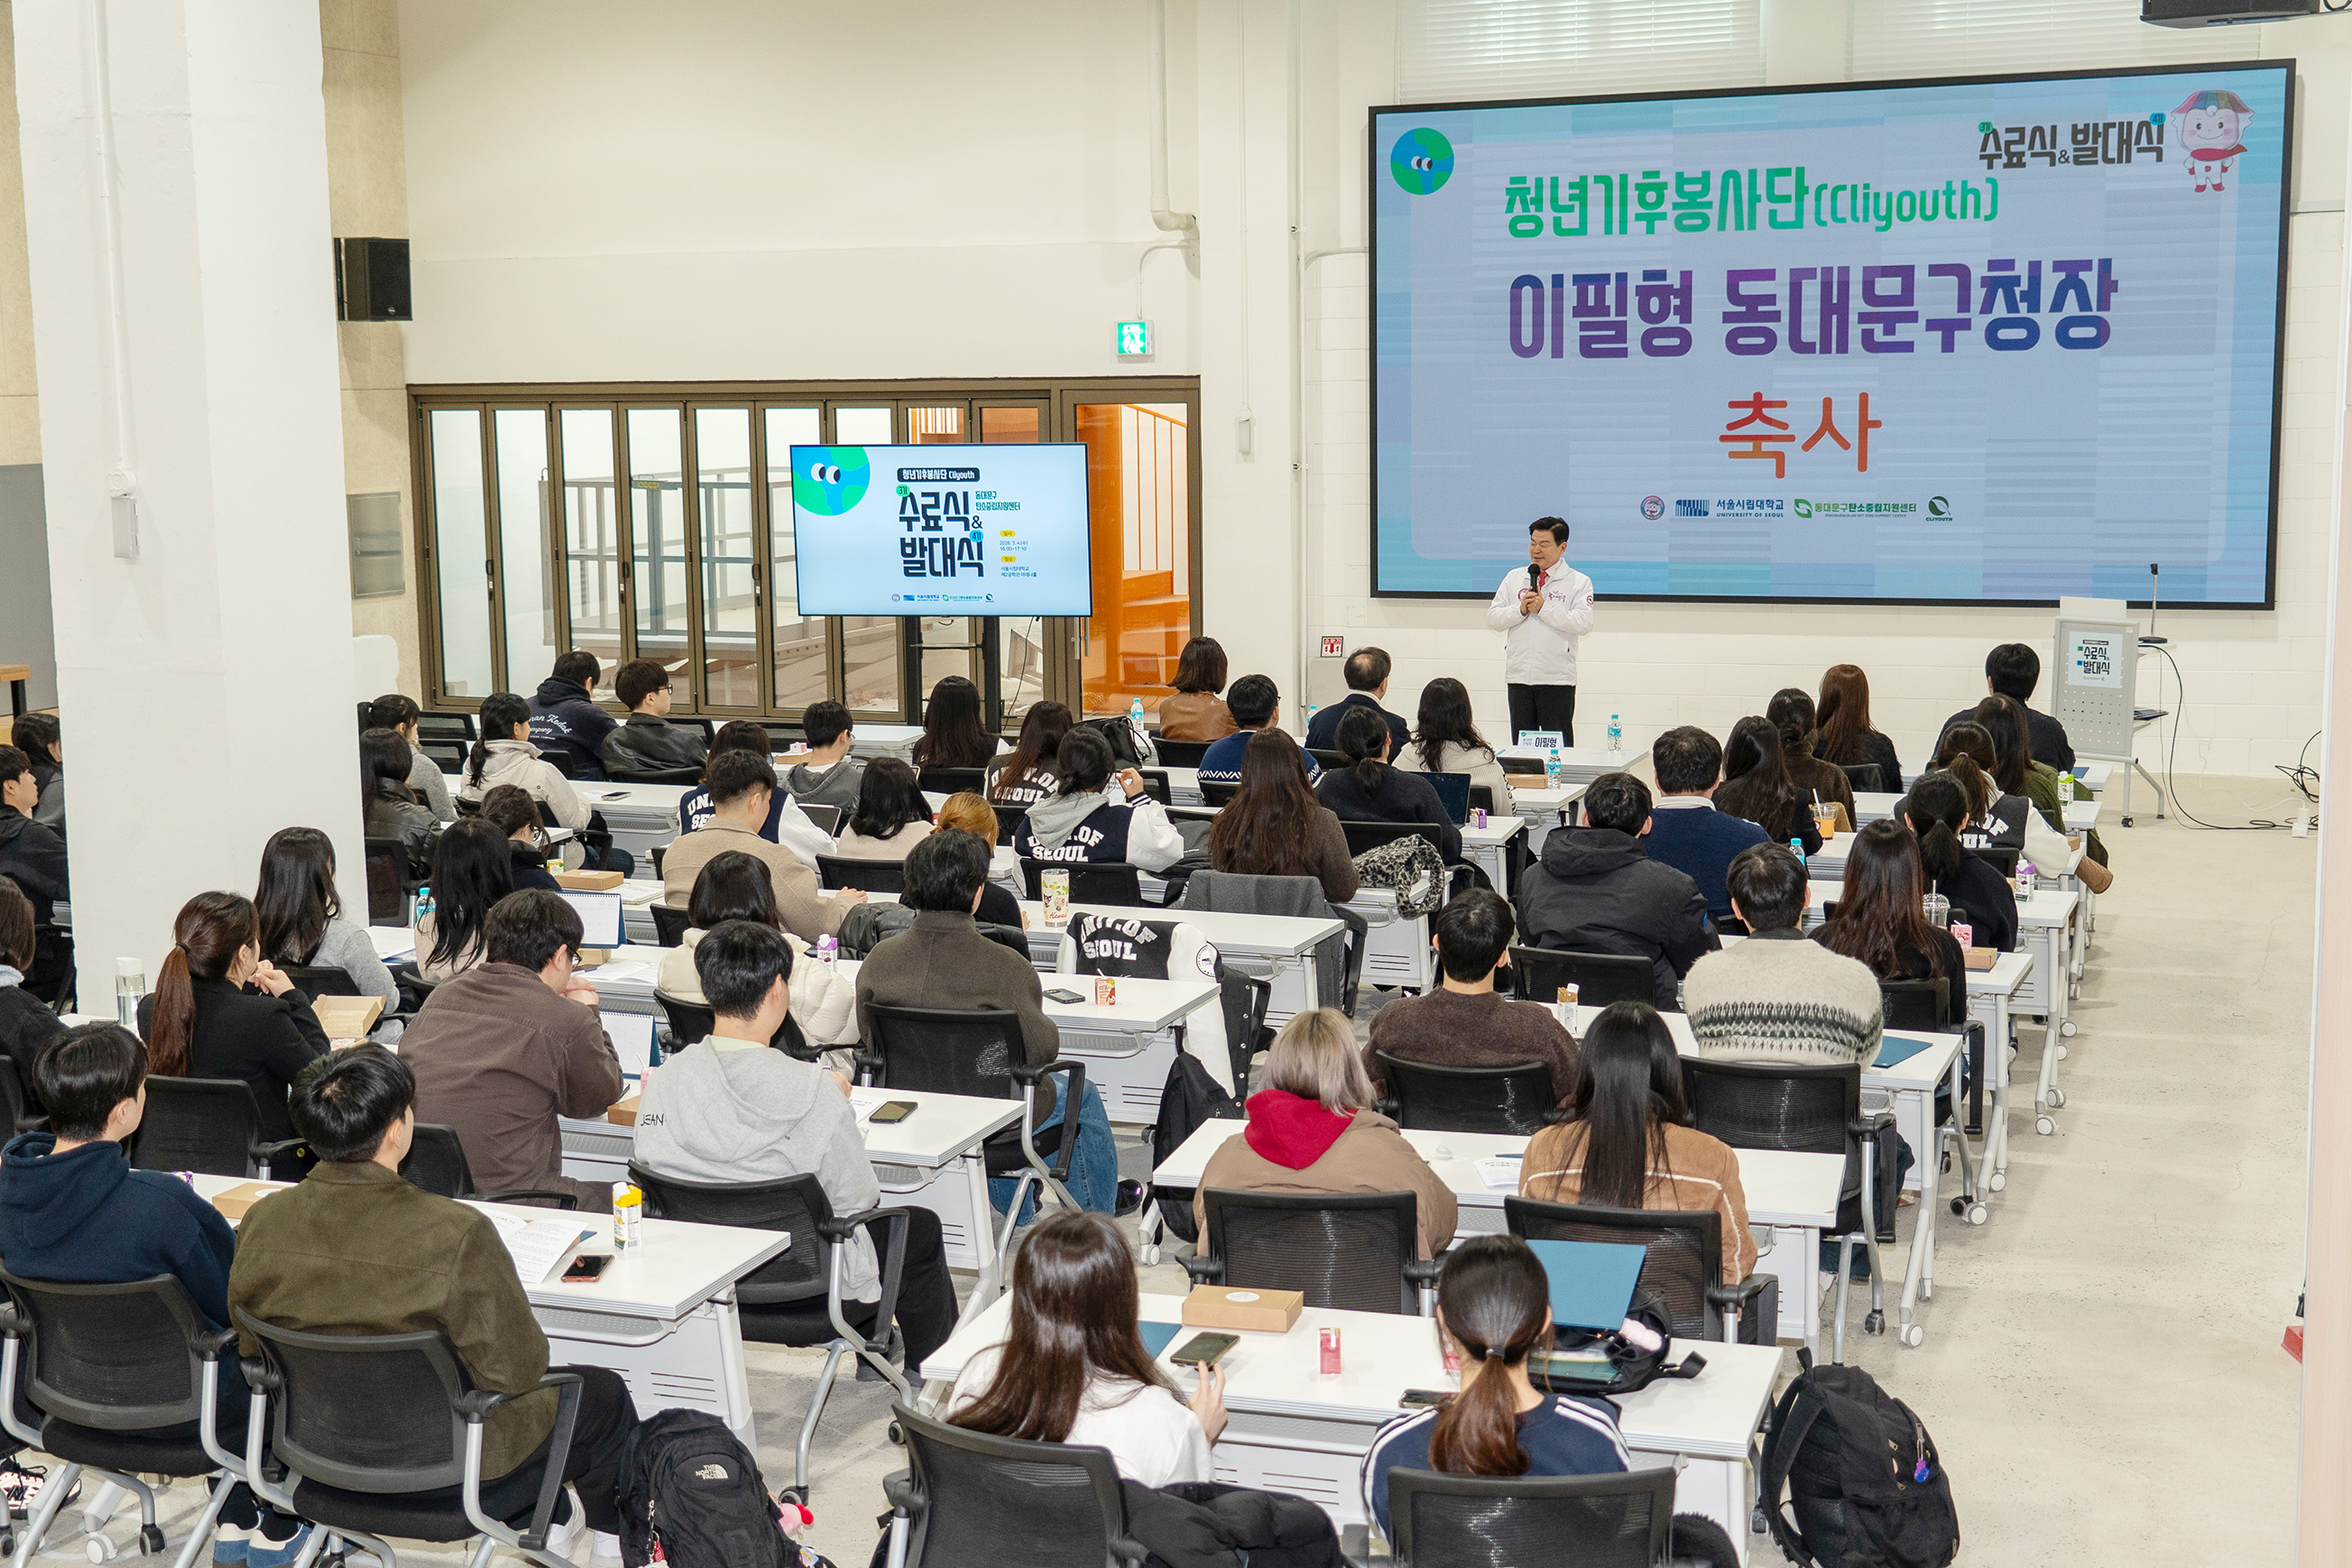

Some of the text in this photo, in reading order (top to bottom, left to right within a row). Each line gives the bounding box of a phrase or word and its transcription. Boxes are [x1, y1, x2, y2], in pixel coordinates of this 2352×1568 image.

[1508, 258, 2118, 359] 이필형 동대문구청장
[1719, 392, 1882, 479] 축사
[902, 469, 975, 481] 청년기후봉사단 Cliyouth
[974, 491, 997, 500] 동대문구
[975, 502, 1020, 511] 탄소중립지원센터
[1716, 499, 1784, 510] 서울시립대학교
[1814, 503, 1916, 512] 동대문구탄소중립지원센터
[899, 537, 983, 577] 발대식
[2083, 660, 2109, 675] 발대식
[547, 714, 572, 734] Kodak
[1535, 736, 1557, 748] 이필형
[1032, 845, 1088, 862] SEOUL
[1084, 939, 1137, 961] SOUL
